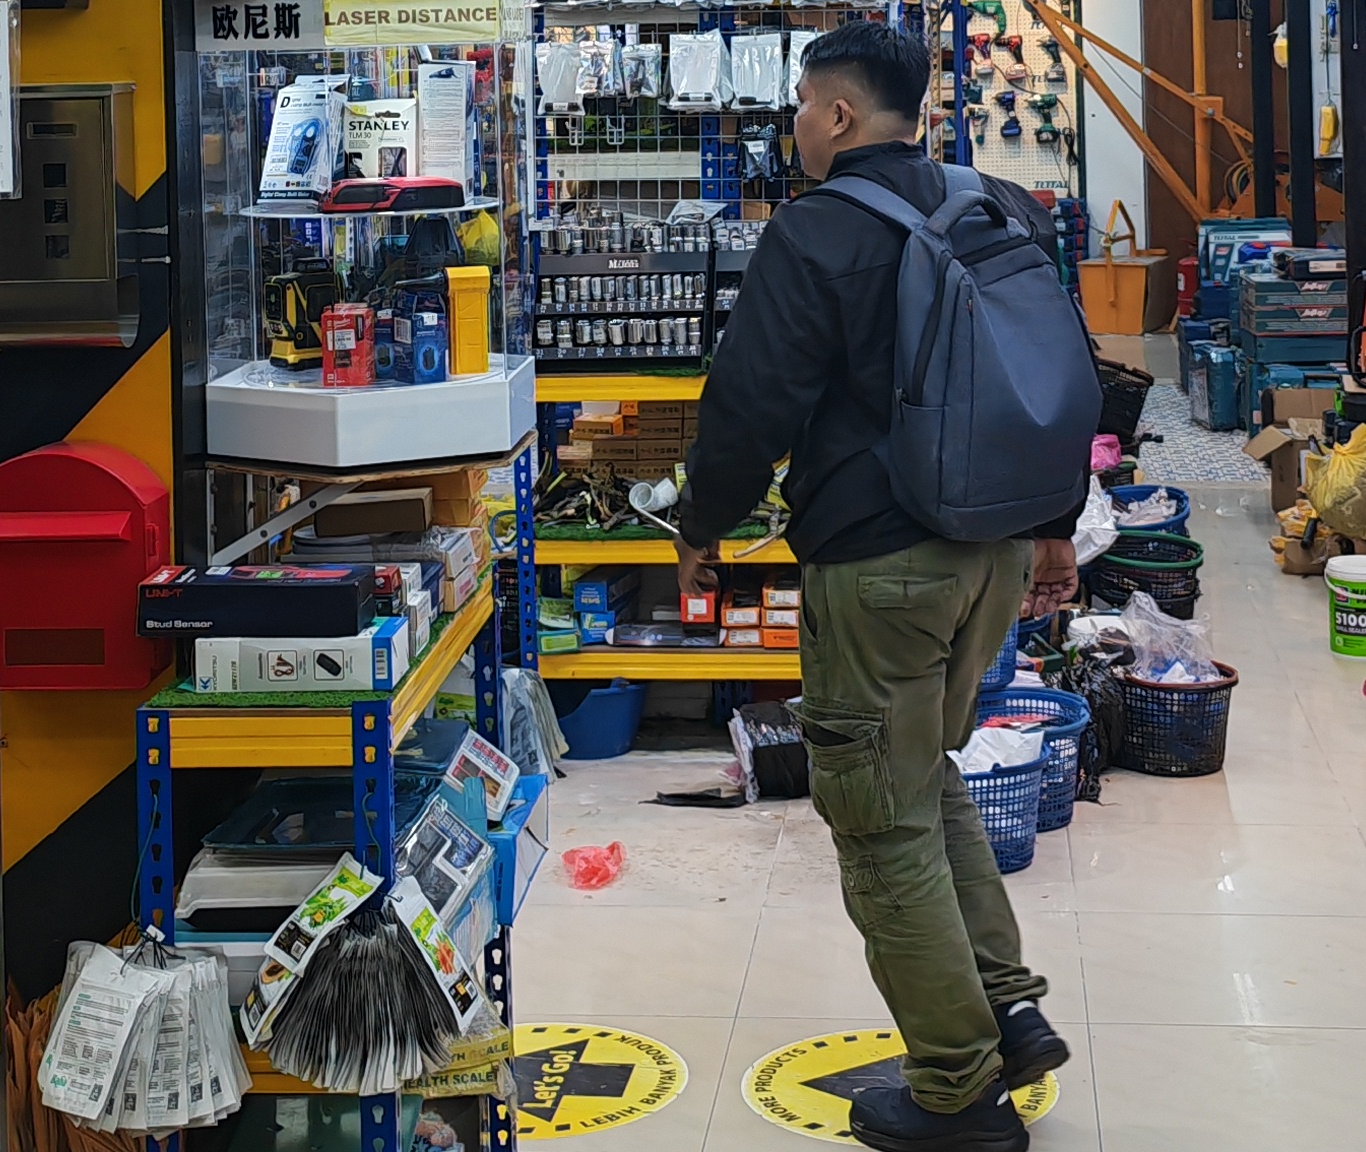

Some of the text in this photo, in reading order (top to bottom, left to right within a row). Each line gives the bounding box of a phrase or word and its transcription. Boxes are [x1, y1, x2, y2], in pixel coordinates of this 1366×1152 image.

[212, 3, 301, 41] 欧尼斯
[325, 6, 497, 27] LASER DISTANCE
[349, 120, 409, 131] STANLEY
[146, 620, 213, 629] Stud Sensor
[524, 1049, 578, 1110] Let's Go!
[579, 1033, 678, 1129] LEBIH BANYAK PRODUK
[756, 1046, 809, 1123] MORE PRODUCTS
